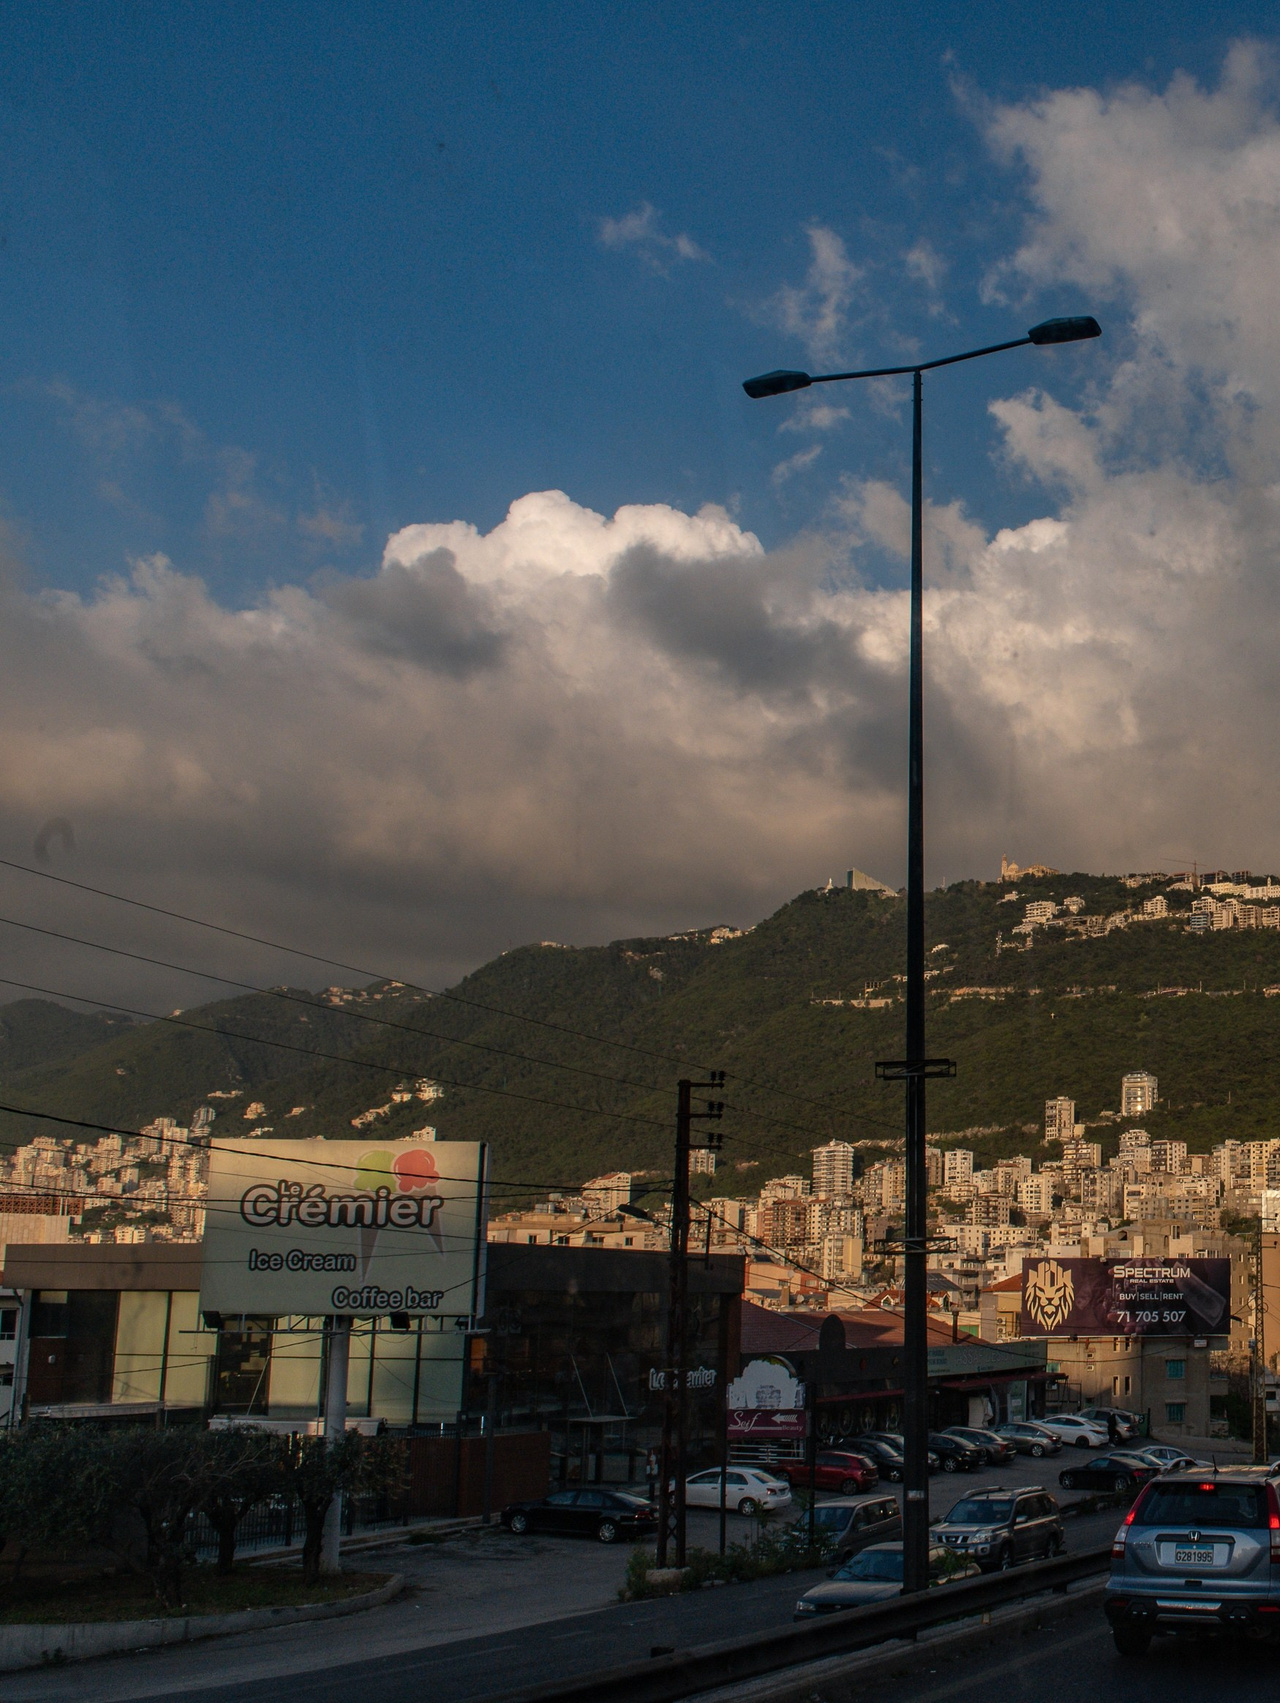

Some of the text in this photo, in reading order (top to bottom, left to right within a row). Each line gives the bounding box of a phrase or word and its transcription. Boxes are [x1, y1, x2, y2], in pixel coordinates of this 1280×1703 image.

[242, 1180, 443, 1227] Le Crémier
[249, 1249, 356, 1271] Ice Cream
[1113, 1265, 1191, 1278] SPECTRUM
[331, 1286, 443, 1309] Coffee bar
[1117, 1311, 1186, 1322] 71 705 507
[782, 1424, 803, 1432] Beauty
[1175, 1552, 1213, 1563] G281995
